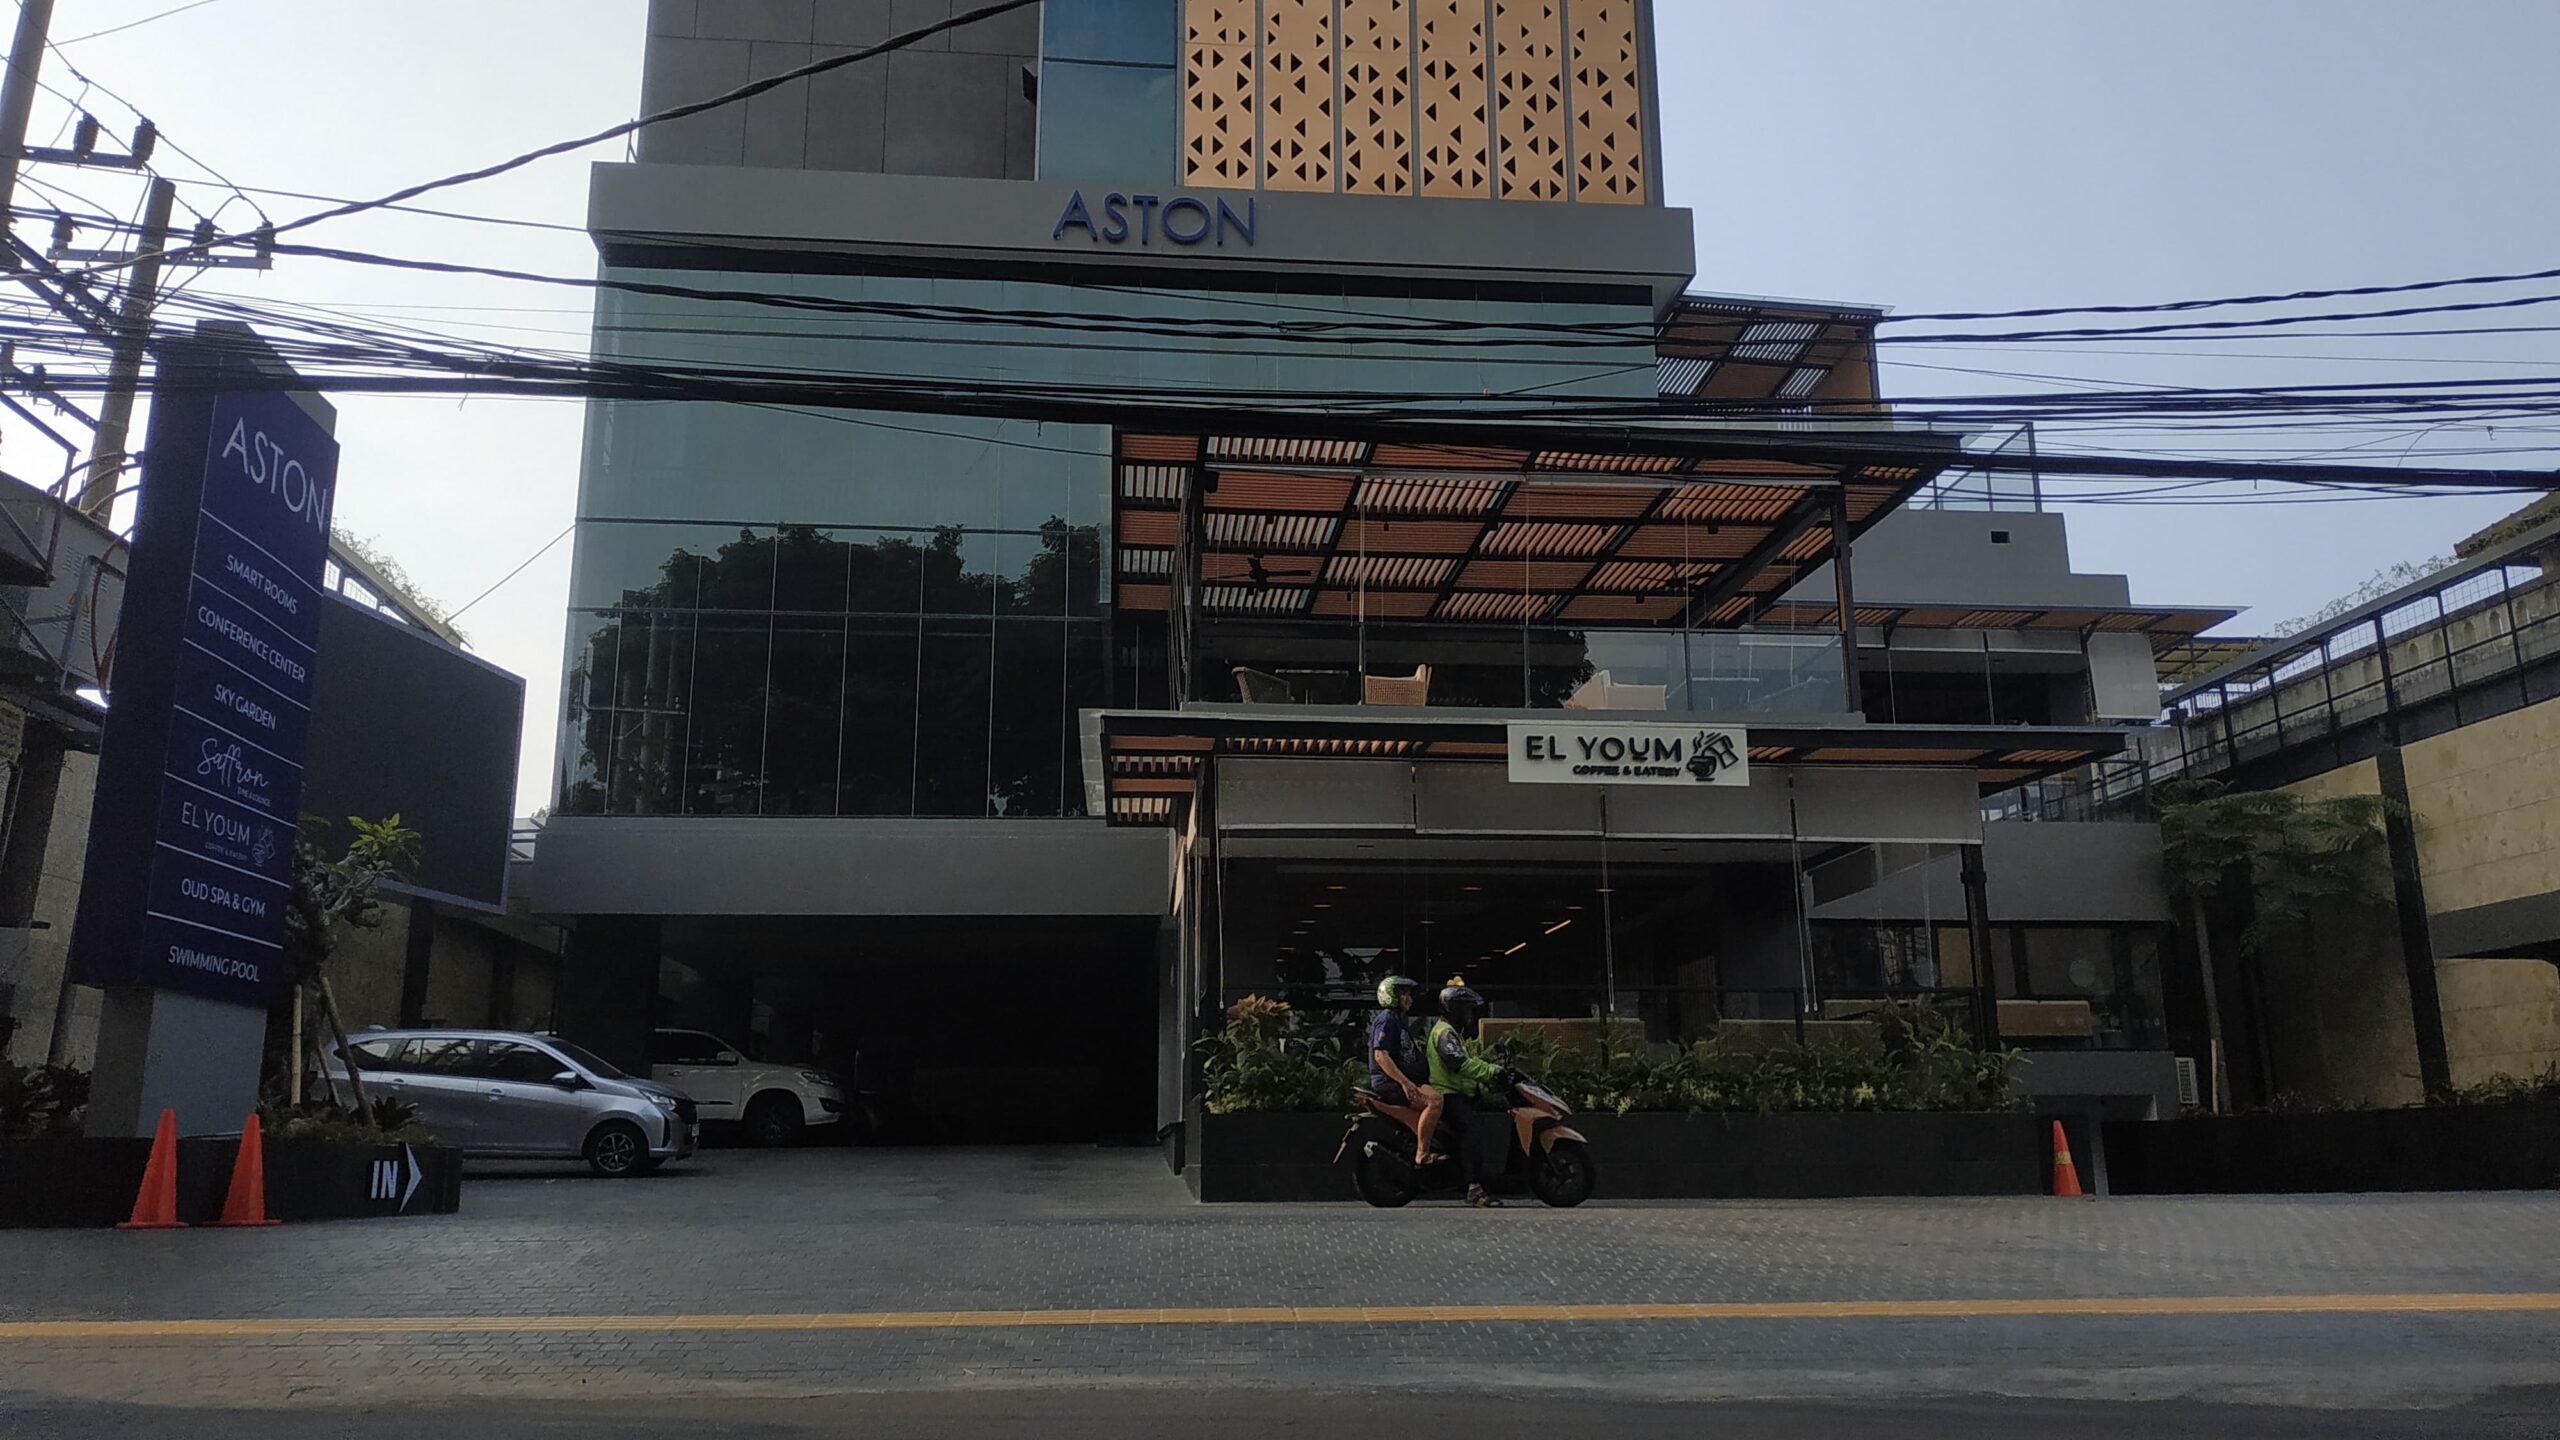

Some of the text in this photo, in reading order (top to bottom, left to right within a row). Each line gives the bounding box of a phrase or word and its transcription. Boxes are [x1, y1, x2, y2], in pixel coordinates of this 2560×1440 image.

[1053, 189, 1255, 246] ASTON
[222, 417, 327, 534] ASTON
[226, 554, 298, 615] SMART ROOMS
[198, 606, 306, 683] CONFERENCE CENTER
[214, 684, 276, 730] SKY GARDEN
[197, 737, 269, 788] Saffron
[1526, 735, 1682, 761] EL YOUM
[1572, 764, 1682, 777] COFFEE & EATERY
[181, 801, 250, 846] EL YOUM
[181, 878, 266, 918] OUD SPA & GYM
[168, 945, 261, 982] SWIMMING POOL
[371, 1160, 398, 1199] IN
